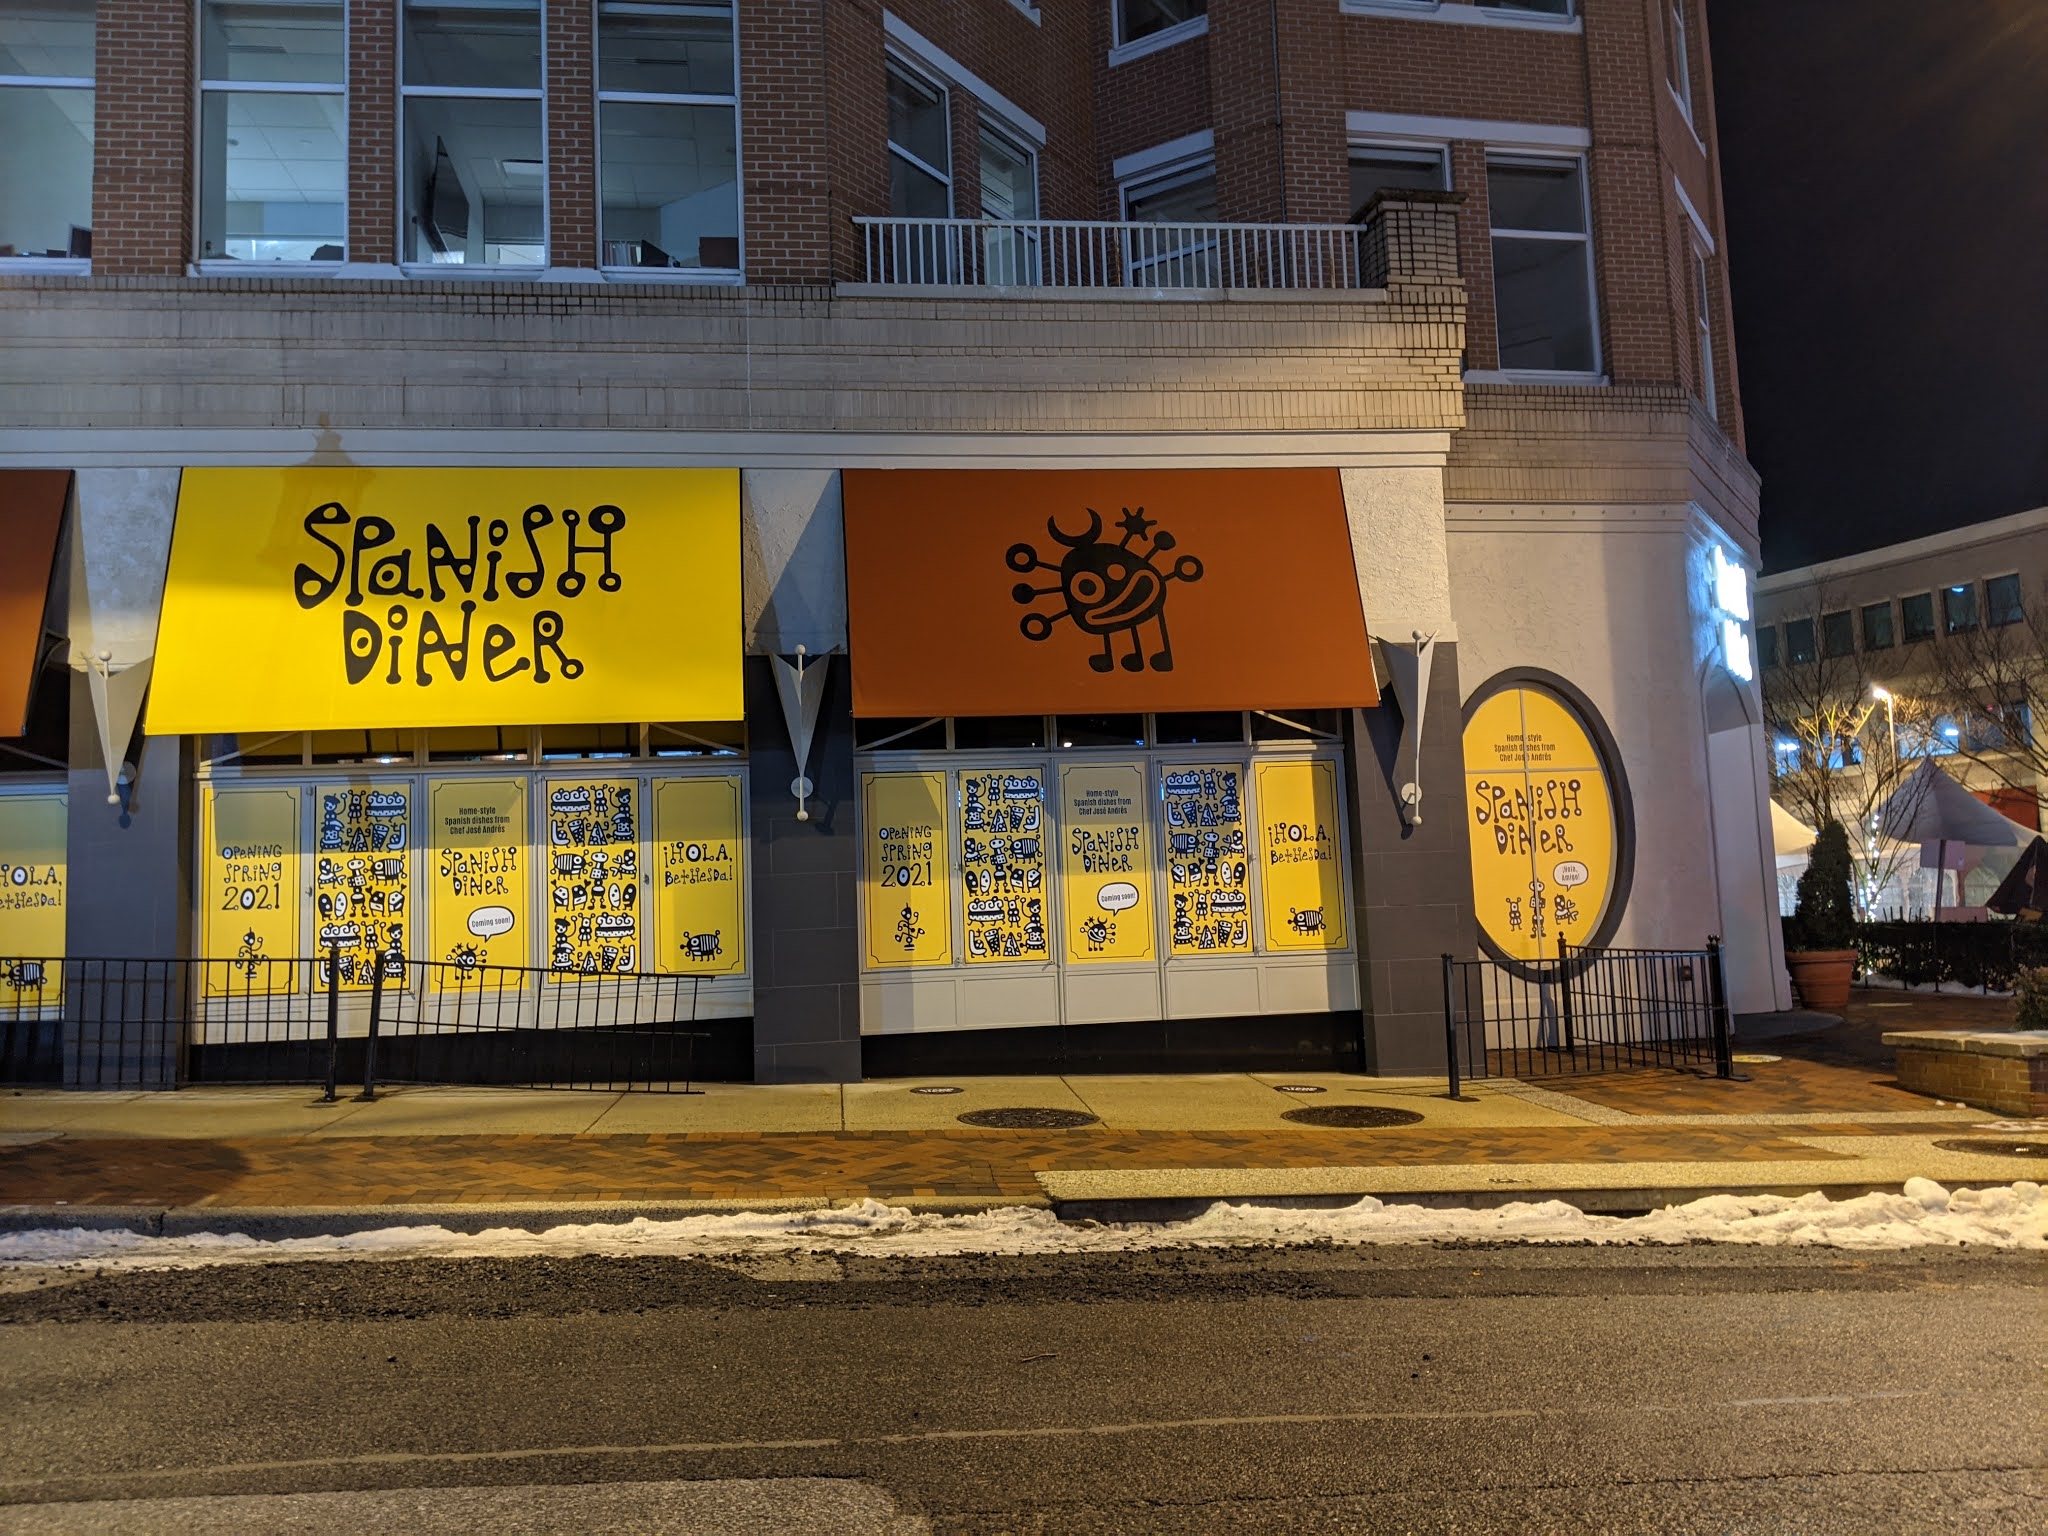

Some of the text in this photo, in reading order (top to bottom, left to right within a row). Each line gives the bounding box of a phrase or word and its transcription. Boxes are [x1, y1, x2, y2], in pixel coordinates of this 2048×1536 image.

[1494, 743, 1556, 753] Spanish dshes from
[1500, 753, 1513, 762] Chef
[1086, 789, 1119, 797] Home-style
[1074, 798, 1097, 807] Spanish
[1097, 798, 1117, 806] dishes
[458, 806, 496, 815] Home-style
[1079, 806, 1128, 815] Chef José Andrés
[444, 815, 510, 826] Spanish dishes from
[450, 824, 506, 835] Chef José Andrés
[881, 860, 932, 887] 2021
[221, 882, 280, 911] 2021
[1101, 891, 1136, 902] Coming soon!
[471, 916, 511, 928] Coming soon!
